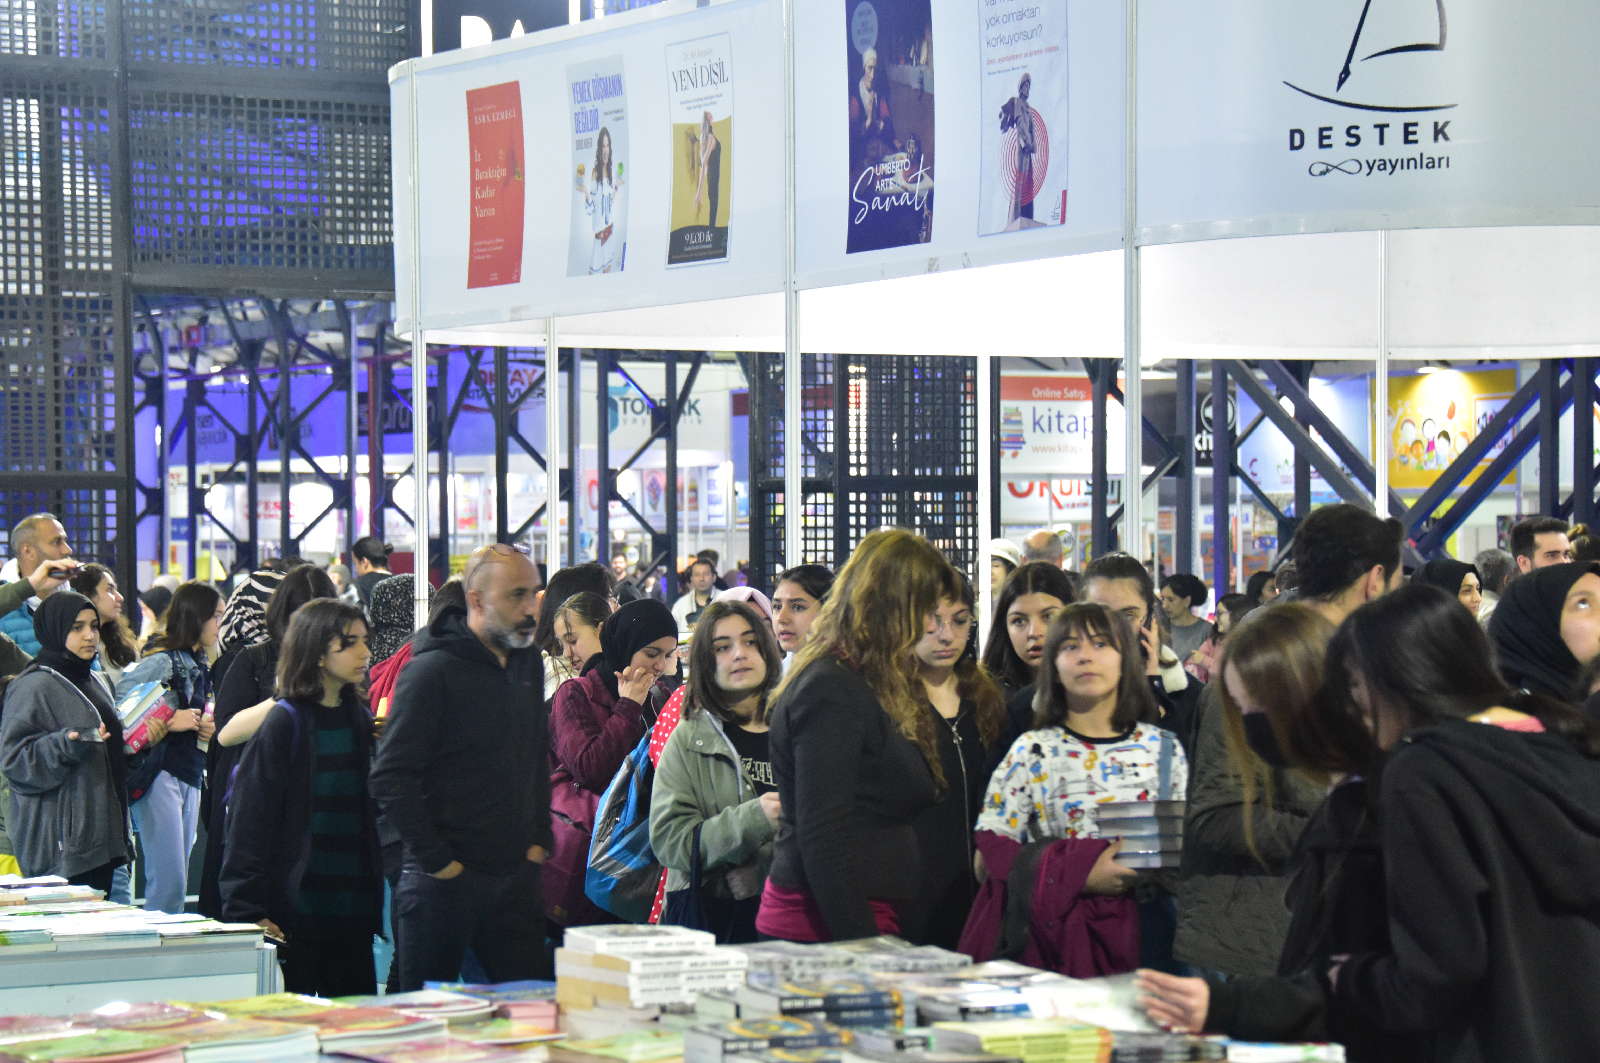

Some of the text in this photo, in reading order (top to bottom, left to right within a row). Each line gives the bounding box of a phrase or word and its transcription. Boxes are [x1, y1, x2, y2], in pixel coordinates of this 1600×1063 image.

[985, 6, 1041, 31] yok olmaktan
[986, 23, 1043, 48] korkuyorsun?
[671, 57, 729, 92] YENİ DİŞİL
[571, 73, 623, 105] YEMEK DÜŞMANIN
[474, 114, 491, 126] ESRA
[492, 106, 516, 122] EZMECİ
[574, 104, 600, 134] DEĞİLDİR
[1289, 120, 1451, 151] DESTEK
[474, 145, 482, 162] İz
[475, 165, 507, 181] Bıraktığın
[875, 158, 911, 176] UMBERTO
[1365, 153, 1450, 176] yayınları
[475, 186, 496, 200] Kadar
[852, 153, 931, 225] Sanat
[874, 177, 894, 192] ARTE
[475, 205, 496, 219] Varsın
[684, 233, 690, 245] 9
[1031, 386, 1062, 399] Online
[1032, 406, 1093, 440] kitap
